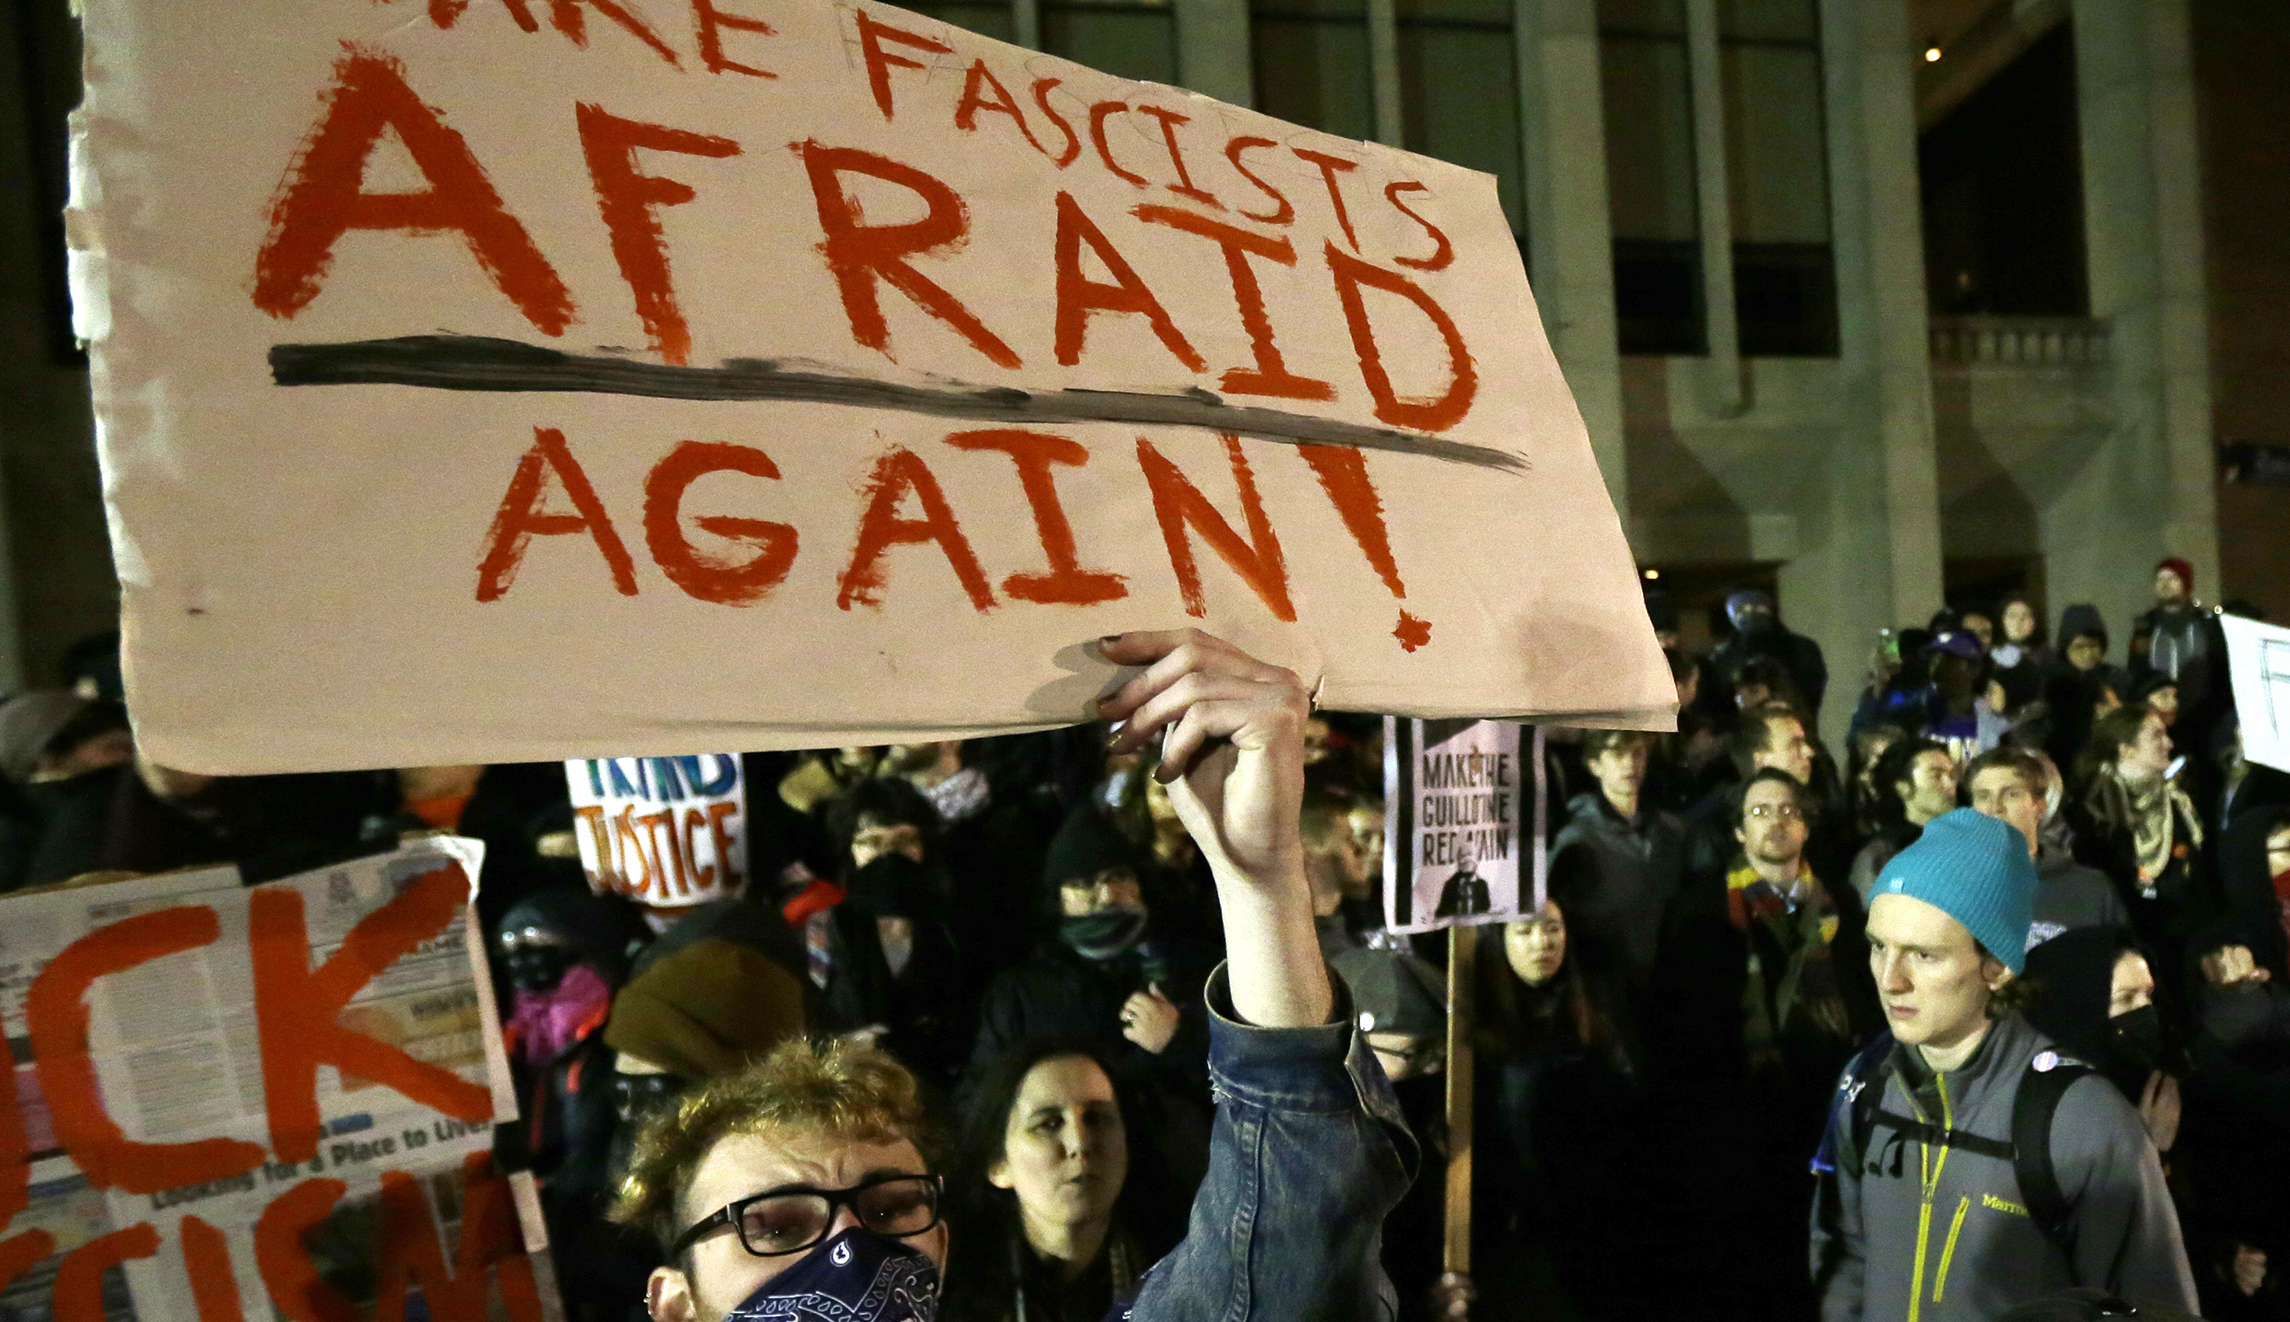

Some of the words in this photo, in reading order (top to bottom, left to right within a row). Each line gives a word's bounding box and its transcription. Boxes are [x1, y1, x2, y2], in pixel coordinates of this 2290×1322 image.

[855, 7, 1455, 272] FASCISTS
[251, 40, 1478, 434] AFRAID
[476, 426, 1433, 653] AGAIN!
[1423, 753, 1476, 788] MAKE
[1475, 753, 1510, 788] THE
[1423, 794, 1510, 826] GUILLOTINE
[574, 801, 742, 898] JUSTICE
[331, 1136, 396, 1167] Place
[402, 1128, 428, 1150] to
